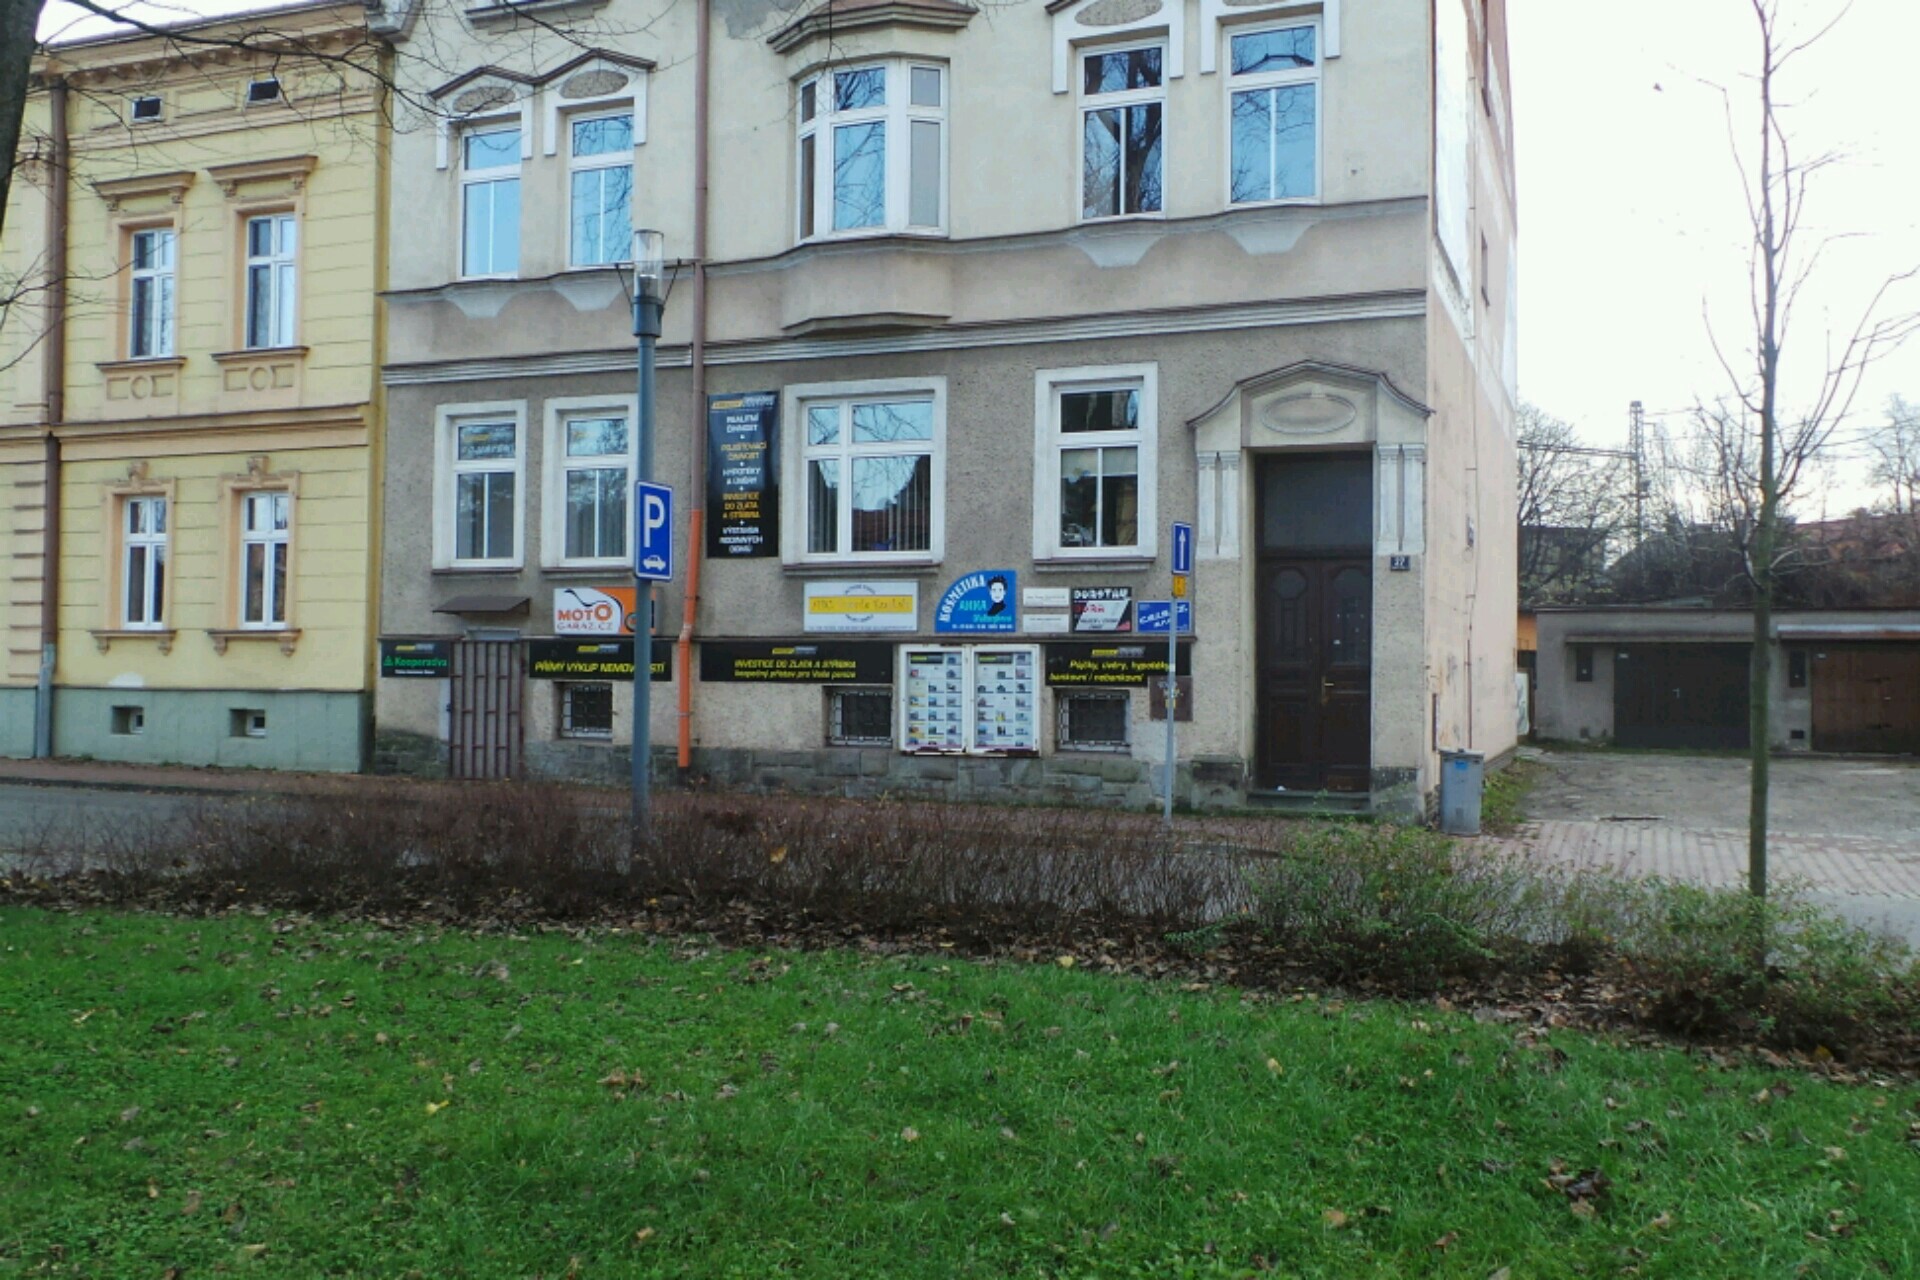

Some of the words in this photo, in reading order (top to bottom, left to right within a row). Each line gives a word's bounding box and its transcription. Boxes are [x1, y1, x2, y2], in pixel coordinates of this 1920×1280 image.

[643, 494, 666, 549] P
[938, 574, 986, 622] KOSMETIKA
[558, 604, 613, 621] MOTO
[394, 655, 448, 668] Kooperativa
[566, 660, 599, 672] VÝKUP
[734, 659, 774, 668] INVESTICE
[776, 659, 787, 668] DO
